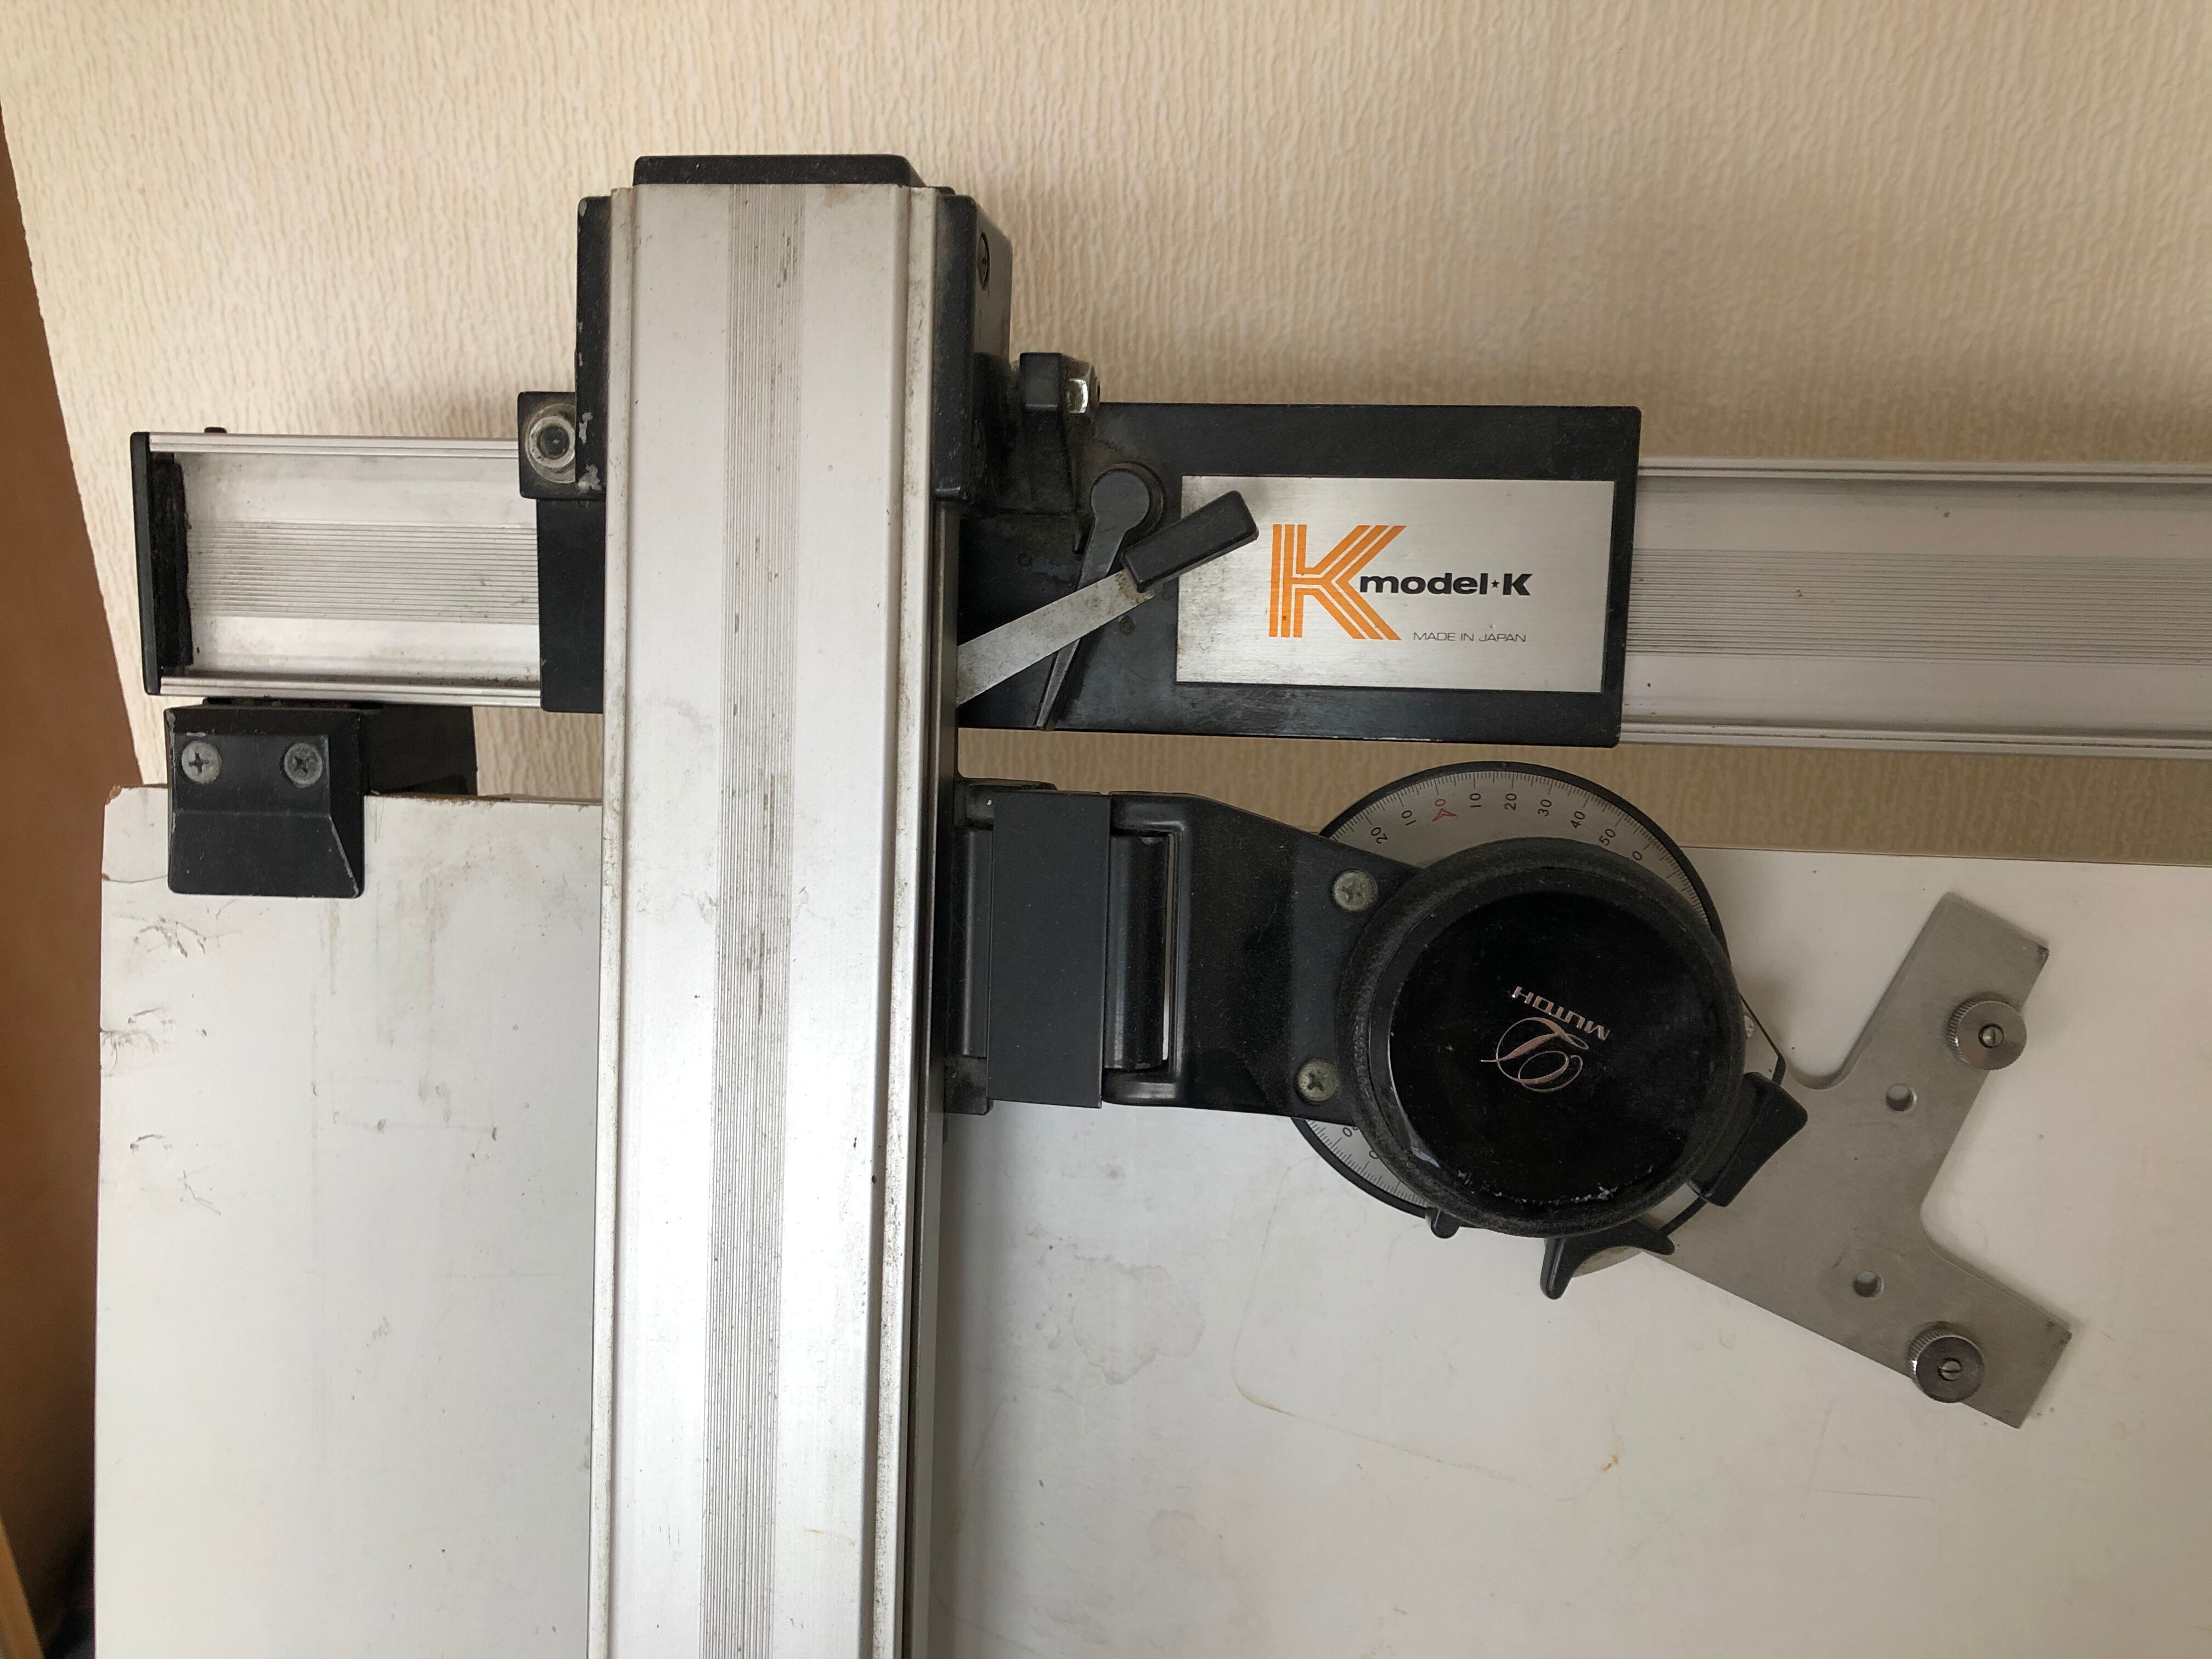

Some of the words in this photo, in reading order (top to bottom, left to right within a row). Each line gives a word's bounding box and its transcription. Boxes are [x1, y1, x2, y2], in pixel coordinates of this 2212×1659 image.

[1413, 632, 1456, 641] MADE
[1460, 633, 1474, 641] IN
[1479, 633, 1526, 642] JAPAN
[1435, 798, 1446, 807] 0
[1469, 793, 1482, 808] 10
[1504, 793, 1517, 811] 20
[1537, 799, 1552, 817] 30
[1401, 810, 1417, 826] 10
[1570, 811, 1585, 829] 40
[1371, 826, 1389, 844] 20
[1599, 828, 1616, 846] 50
[1632, 850, 1643, 861] 0
[1511, 986, 1611, 1041] MUTOH
